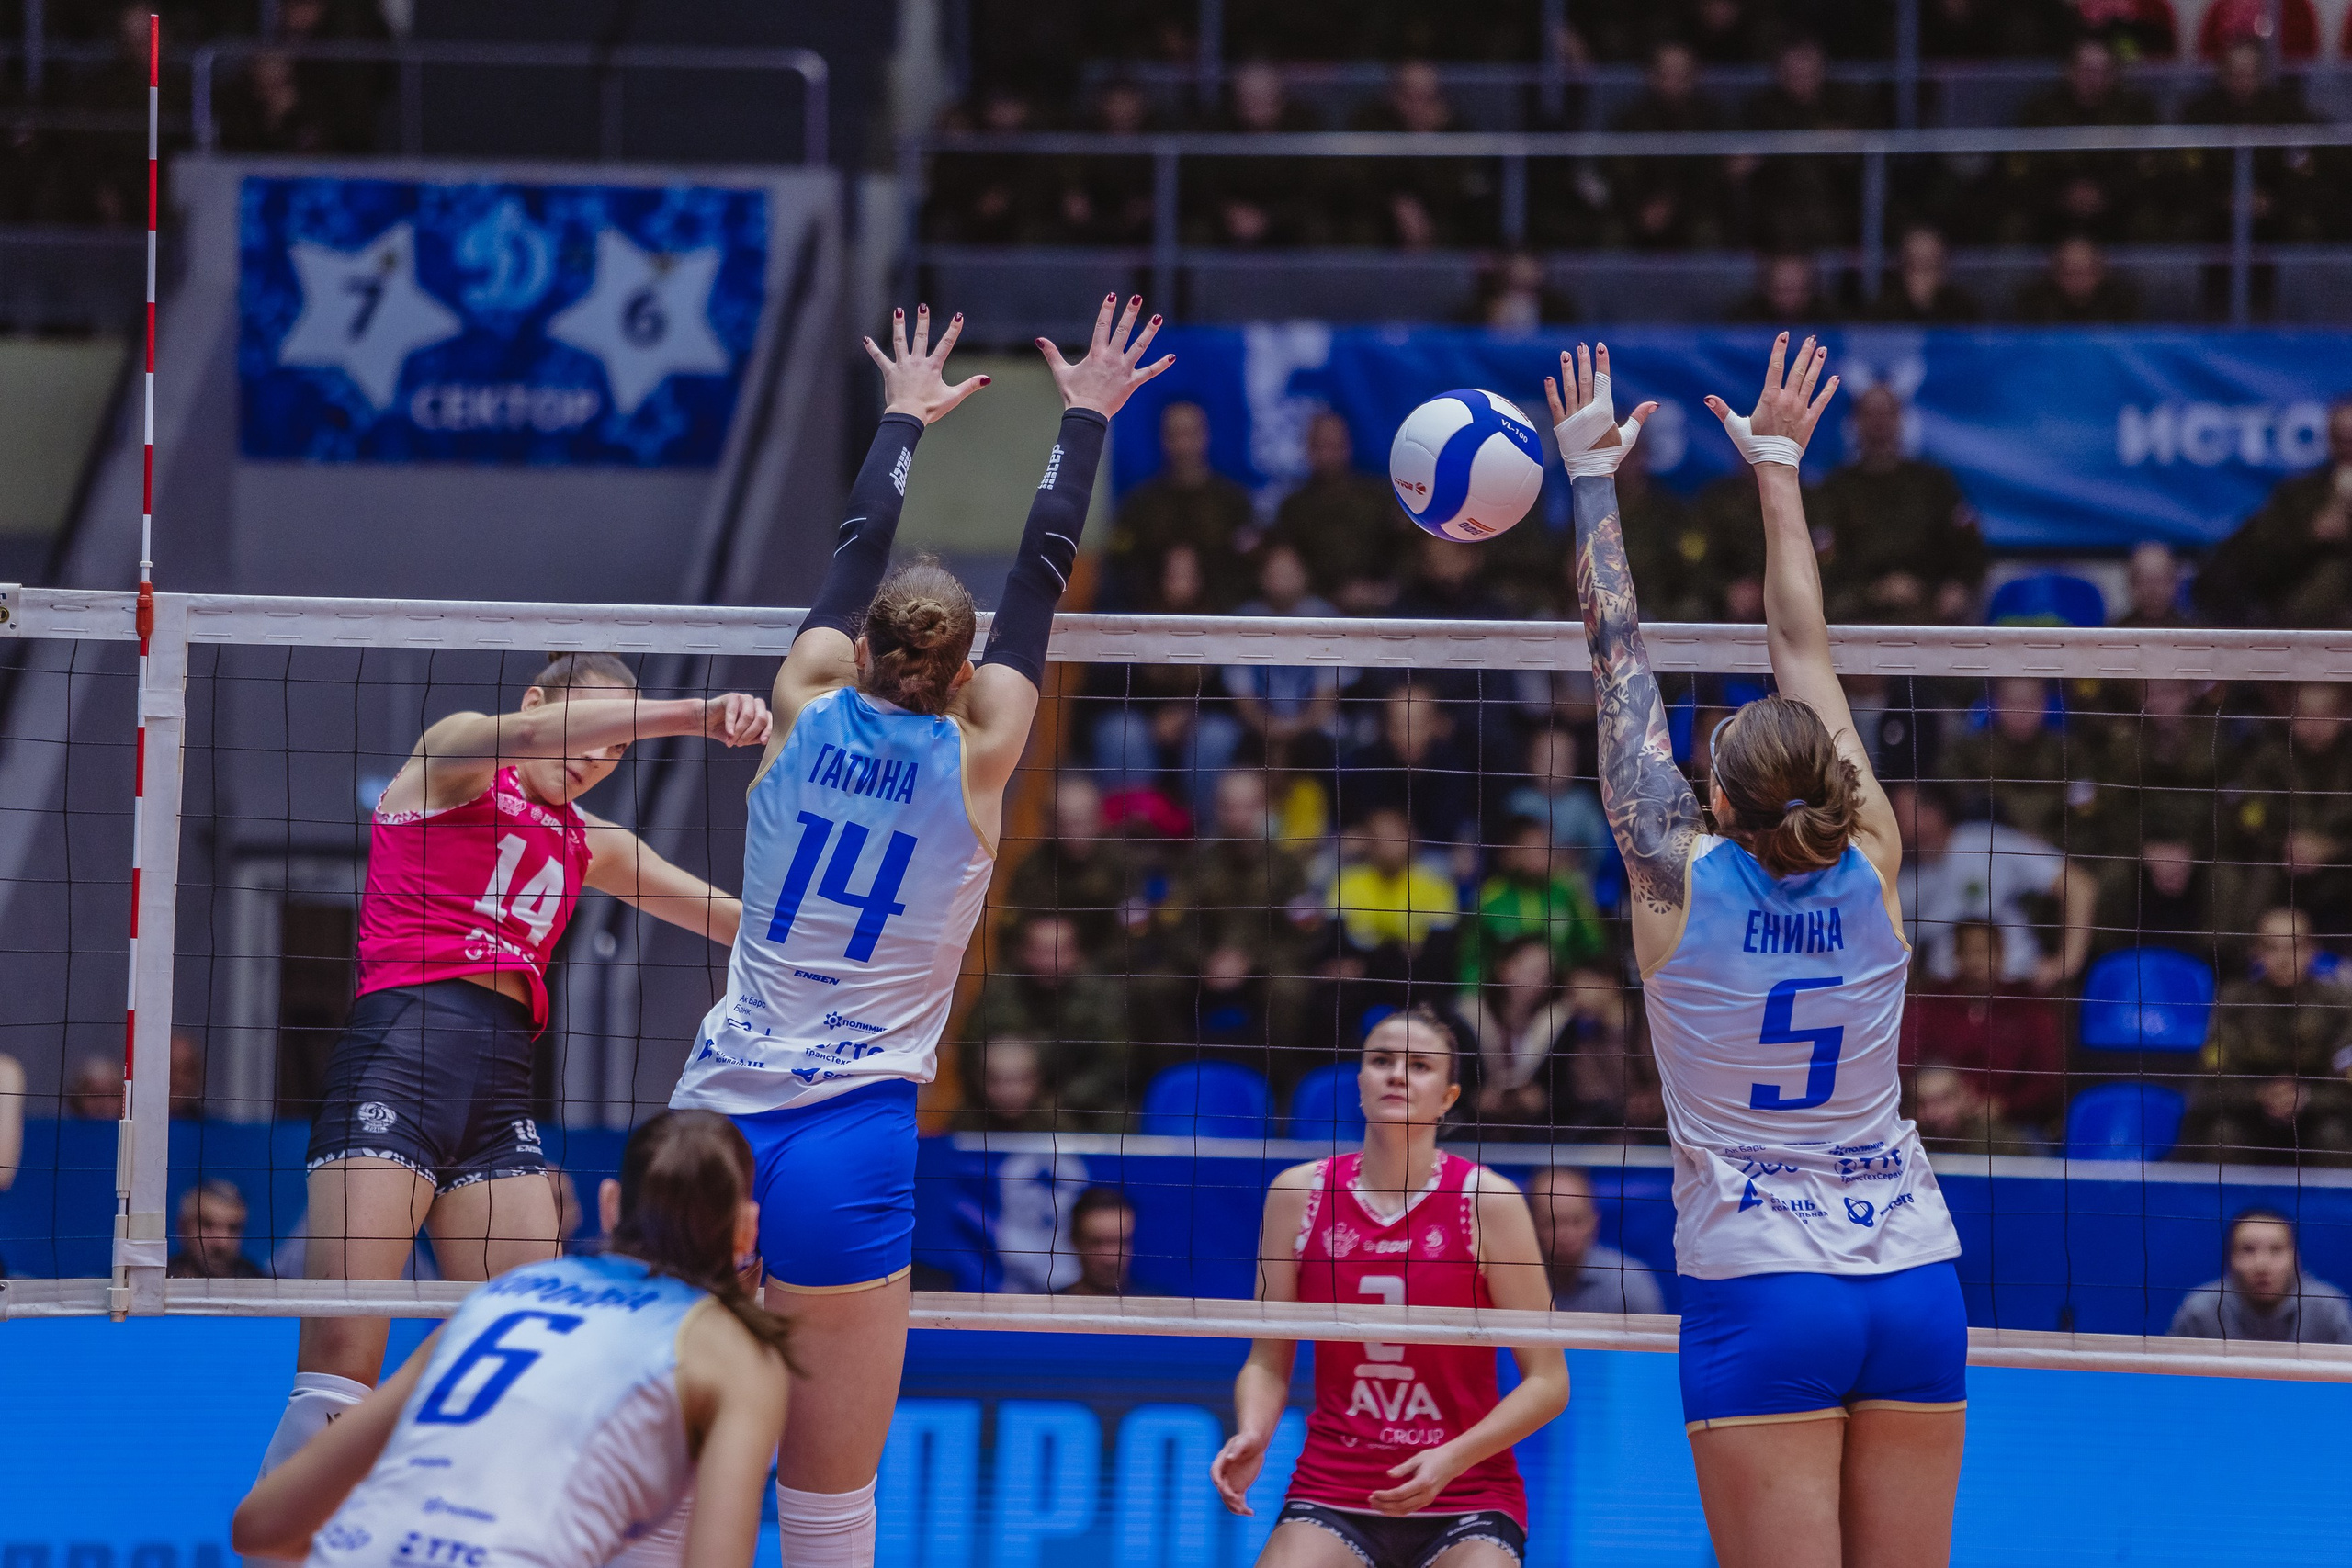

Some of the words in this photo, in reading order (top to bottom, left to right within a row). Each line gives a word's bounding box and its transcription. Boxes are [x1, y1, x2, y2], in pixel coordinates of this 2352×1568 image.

[341, 277, 382, 345] 7
[619, 287, 669, 351] 6
[410, 384, 601, 433] СЕКТОР
[1501, 418, 1529, 444] VL-100
[808, 742, 919, 805] ГАТИНА
[473, 832, 566, 948] 14
[766, 810, 919, 964] 14
[1743, 906, 1844, 954] ЕНИНА
[733, 1003, 752, 1016] Банк
[740, 994, 749, 1003] Ак
[748, 996, 766, 1009] Барс
[1749, 976, 1845, 1111] 5
[416, 1309, 586, 1427] 6
[1345, 1379, 1443, 1422] AVA
[1379, 1427, 1445, 1446] GROUP
